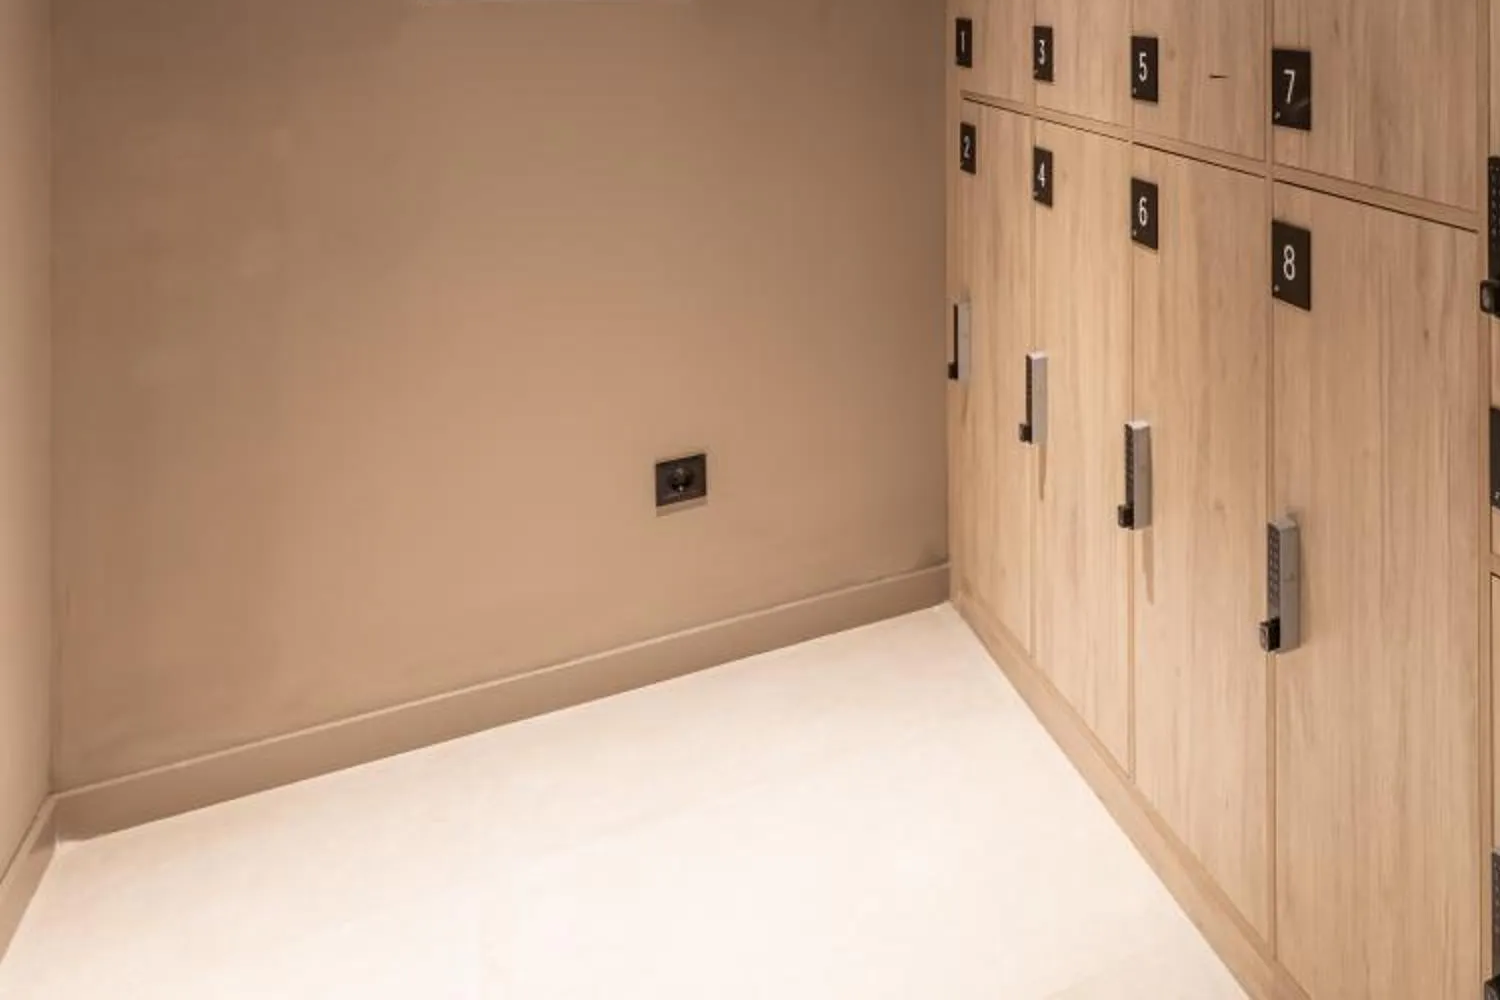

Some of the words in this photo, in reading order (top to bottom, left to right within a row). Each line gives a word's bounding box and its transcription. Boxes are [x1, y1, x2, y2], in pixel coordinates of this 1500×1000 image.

[960, 30, 967, 53] 1
[1038, 38, 1046, 66] 3
[1138, 52, 1148, 83] 5
[1283, 69, 1296, 104] 7
[963, 135, 971, 160] 2
[1037, 161, 1046, 188] 4
[1138, 195, 1148, 227] 6
[1283, 244, 1296, 281] 8
